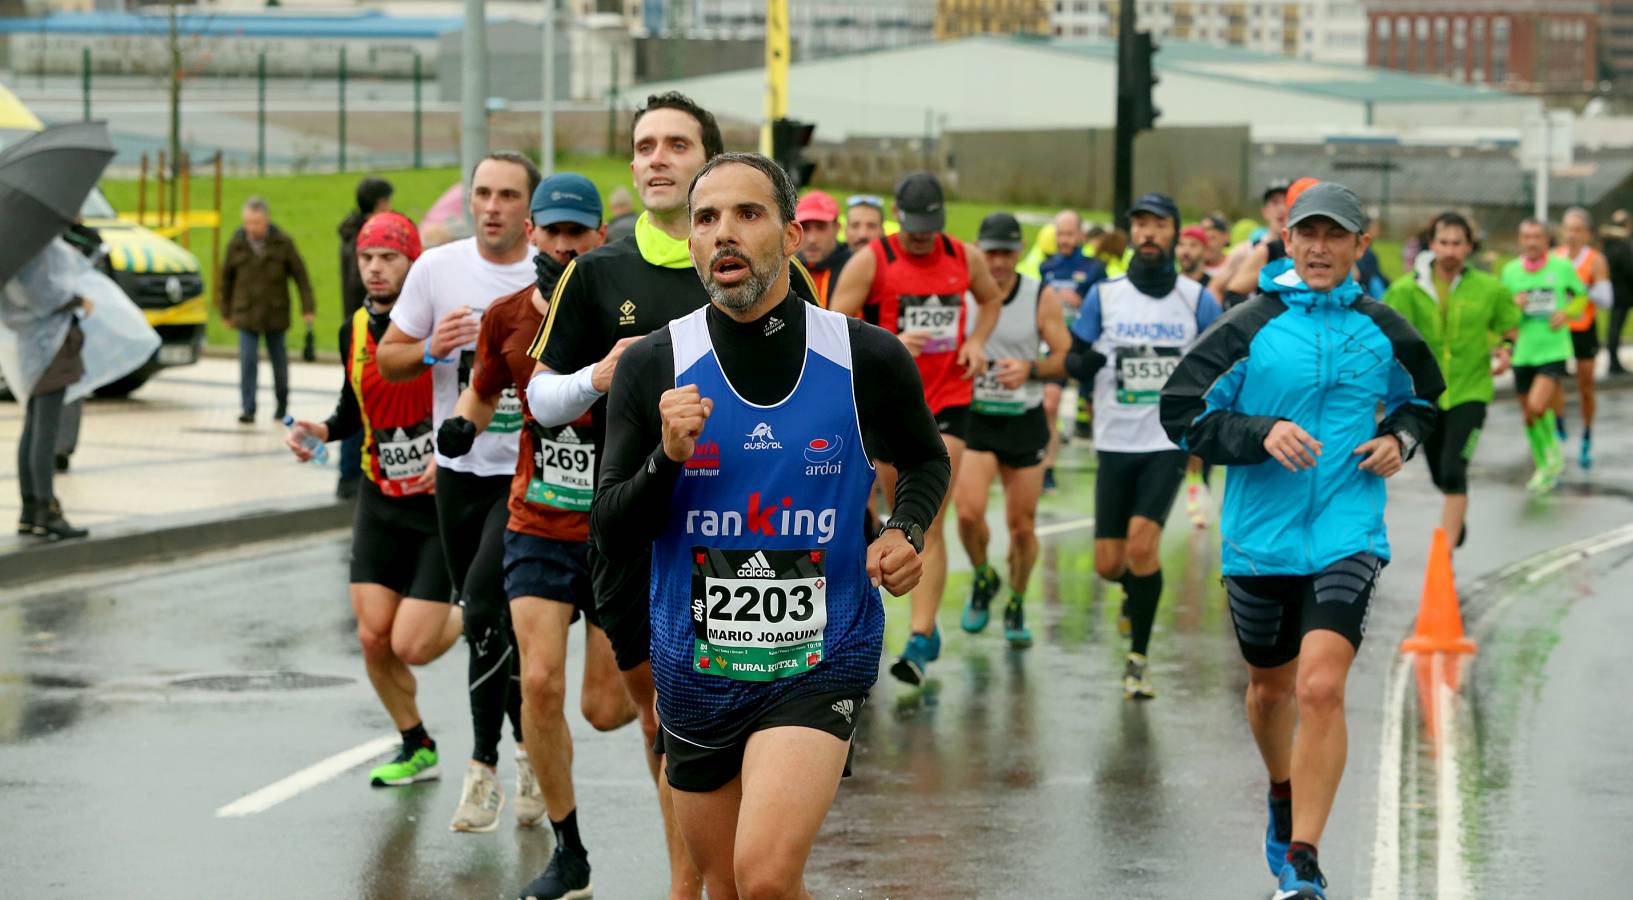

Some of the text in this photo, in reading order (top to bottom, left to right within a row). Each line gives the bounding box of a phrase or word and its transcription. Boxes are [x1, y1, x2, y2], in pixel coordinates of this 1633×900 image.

[911, 311, 955, 327] 1209
[383, 438, 435, 466] 8844
[805, 460, 842, 476] ardoi
[686, 491, 837, 544] ranking
[737, 567, 776, 578] adidas
[691, 599, 707, 622] edp
[708, 585, 815, 623] 2203
[708, 628, 819, 643] MARIO JOAQUIN
[732, 659, 799, 673] RURAL KUTXA
